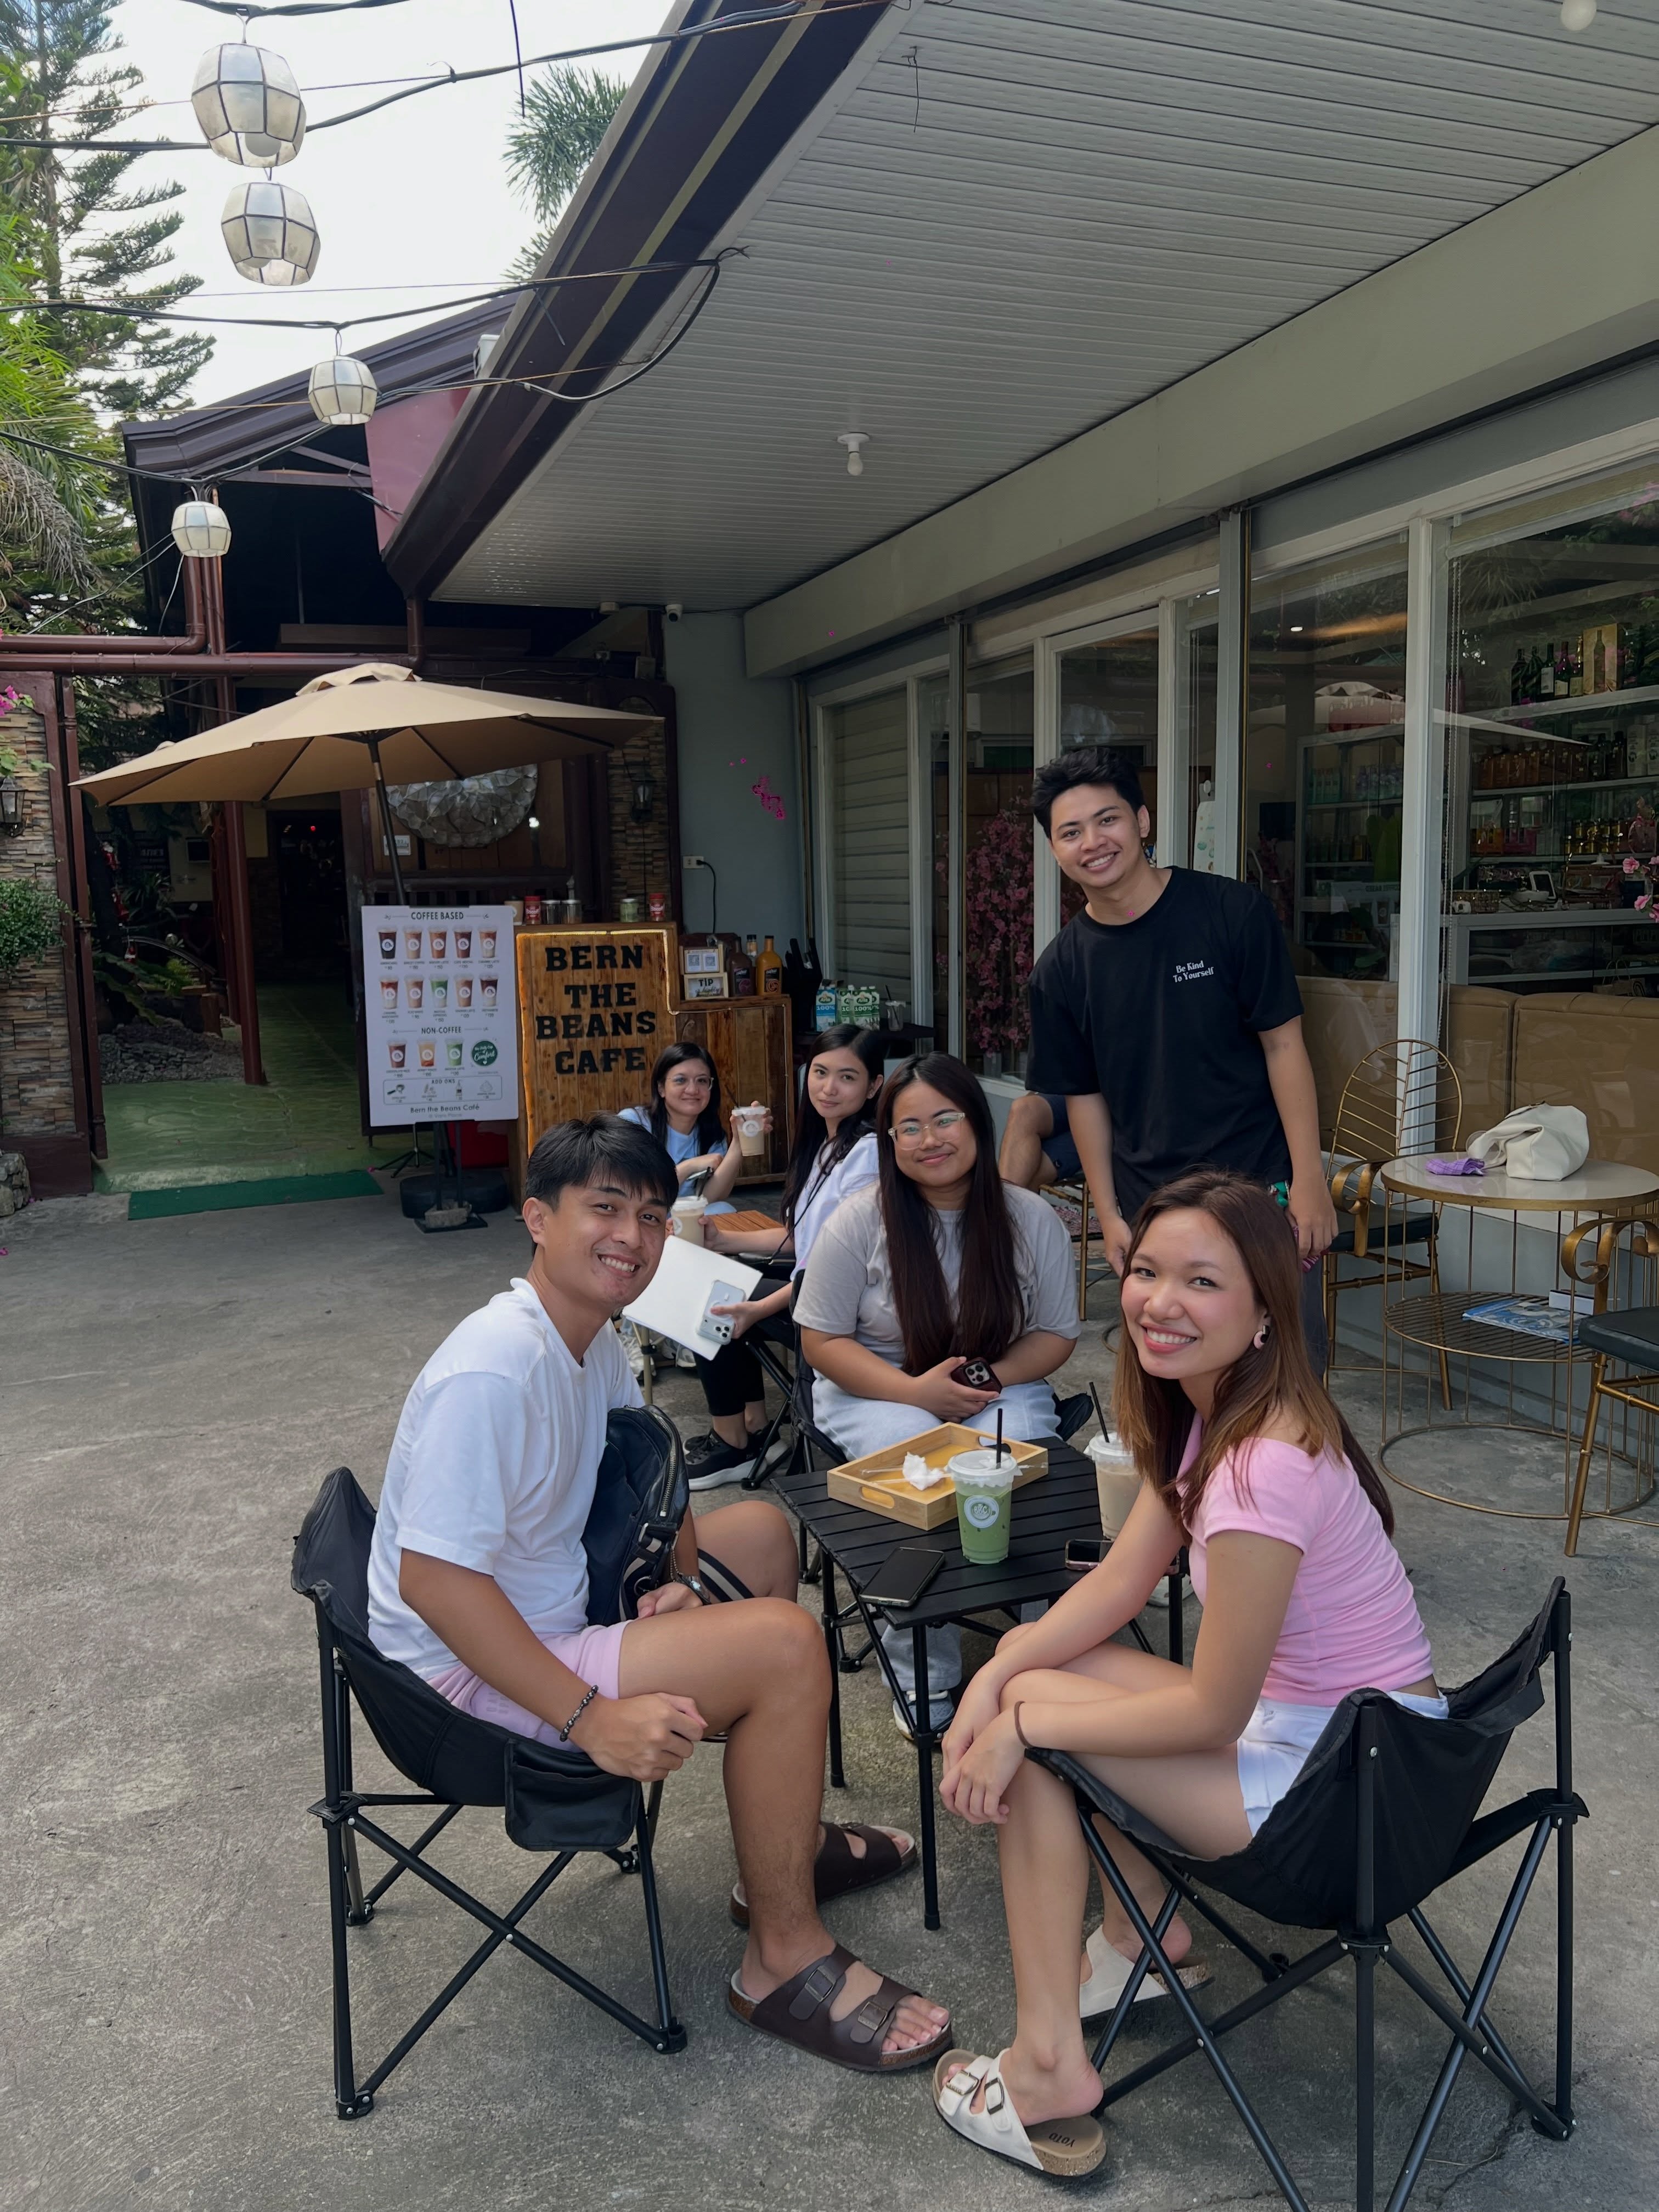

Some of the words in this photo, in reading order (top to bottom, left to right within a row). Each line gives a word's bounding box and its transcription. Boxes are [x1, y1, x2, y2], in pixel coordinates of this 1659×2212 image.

[411, 912, 438, 920] COFFEE
[545, 945, 643, 971] BERN
[1176, 965, 1186, 973] Be
[1187, 960, 1204, 970] Kind
[698, 978, 713, 986] TIP
[1173, 974, 1182, 983] To
[1183, 967, 1214, 980] Yourself
[565, 983, 636, 1008] THE
[535, 1011, 656, 1040] BEANS
[474, 1051, 495, 1061] Comfort
[555, 1047, 646, 1074] CAFE
